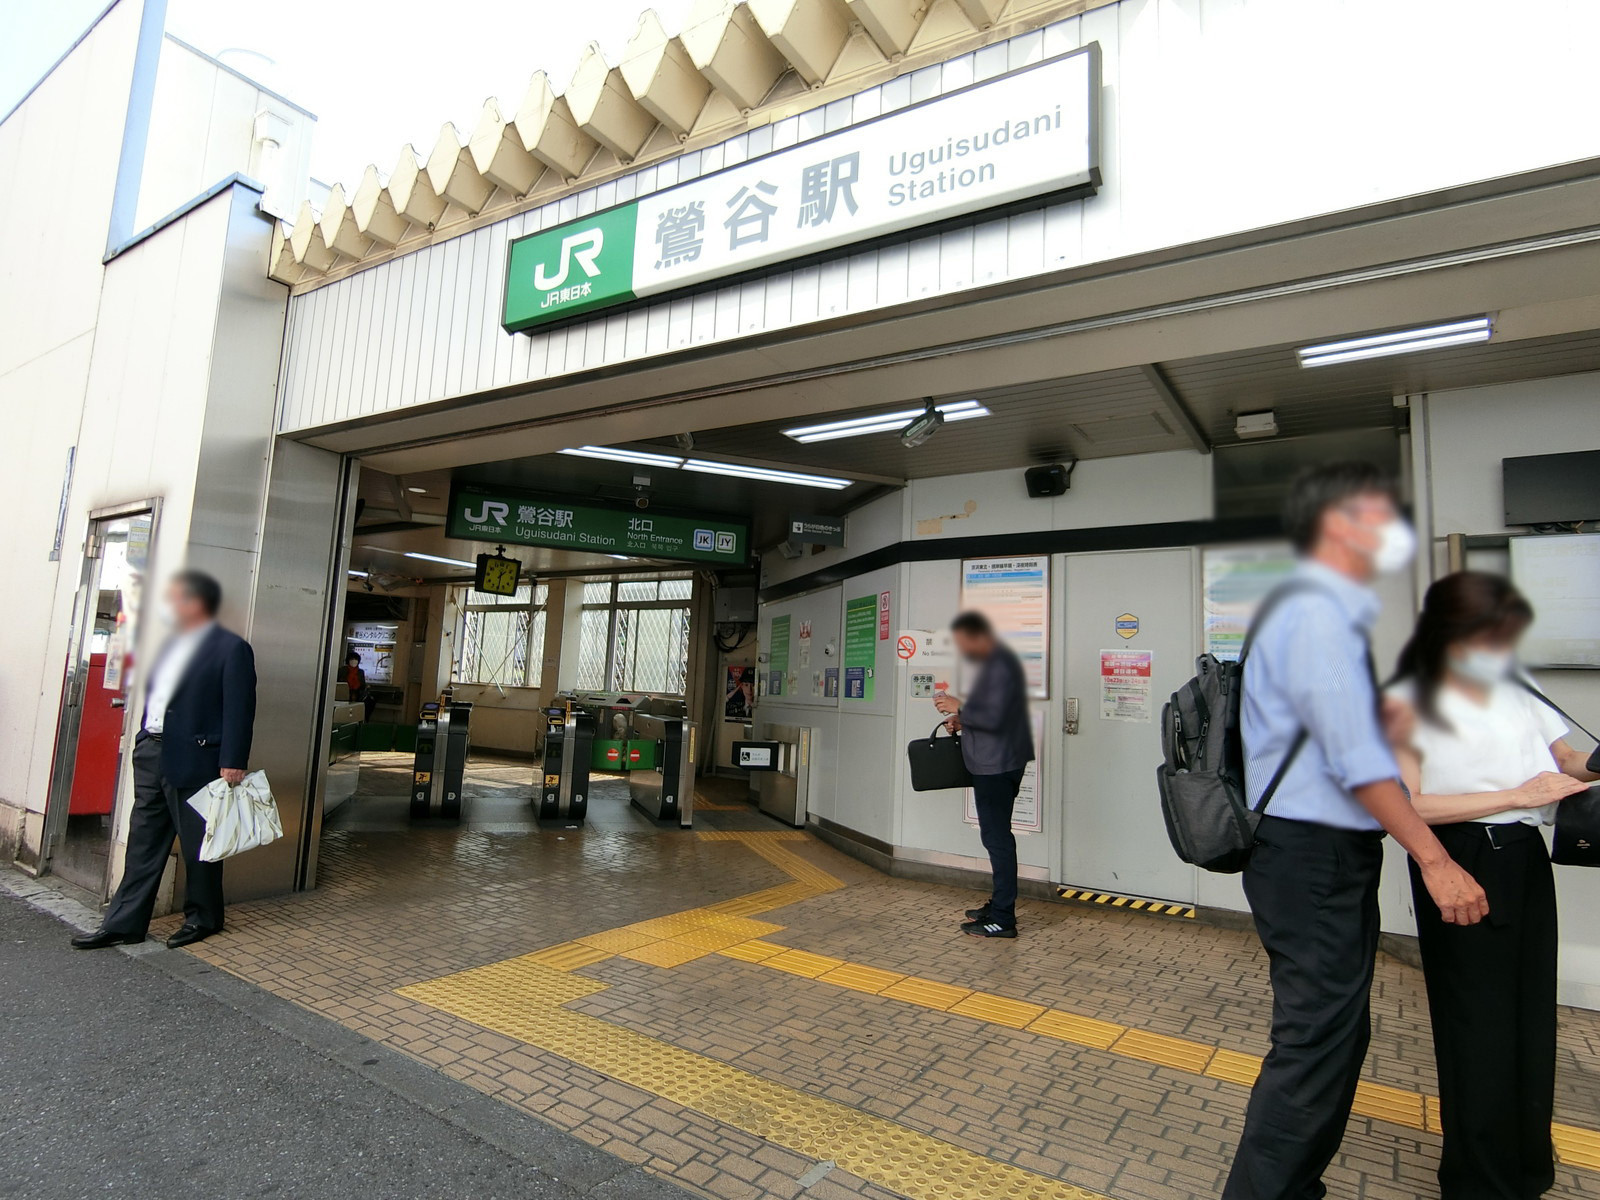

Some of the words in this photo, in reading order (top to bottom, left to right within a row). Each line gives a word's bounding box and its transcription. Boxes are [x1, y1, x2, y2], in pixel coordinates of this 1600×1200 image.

[888, 104, 1061, 176] Uguisudani
[887, 162, 995, 207] Station
[654, 150, 860, 270] 鶯谷駅
[534, 227, 604, 291] JR
[540, 281, 592, 308] JR東日本
[464, 500, 510, 526] JR
[516, 504, 574, 528] 鶯谷駅
[628, 517, 653, 532] 北口
[468, 524, 502, 534] JR東日本
[515, 526, 576, 541] Uguisudani
[579, 532, 616, 546] Station
[627, 532, 649, 541] North
[650, 534, 683, 545] Entrance
[698, 535, 709, 545] JK
[720, 537, 731, 547] JY
